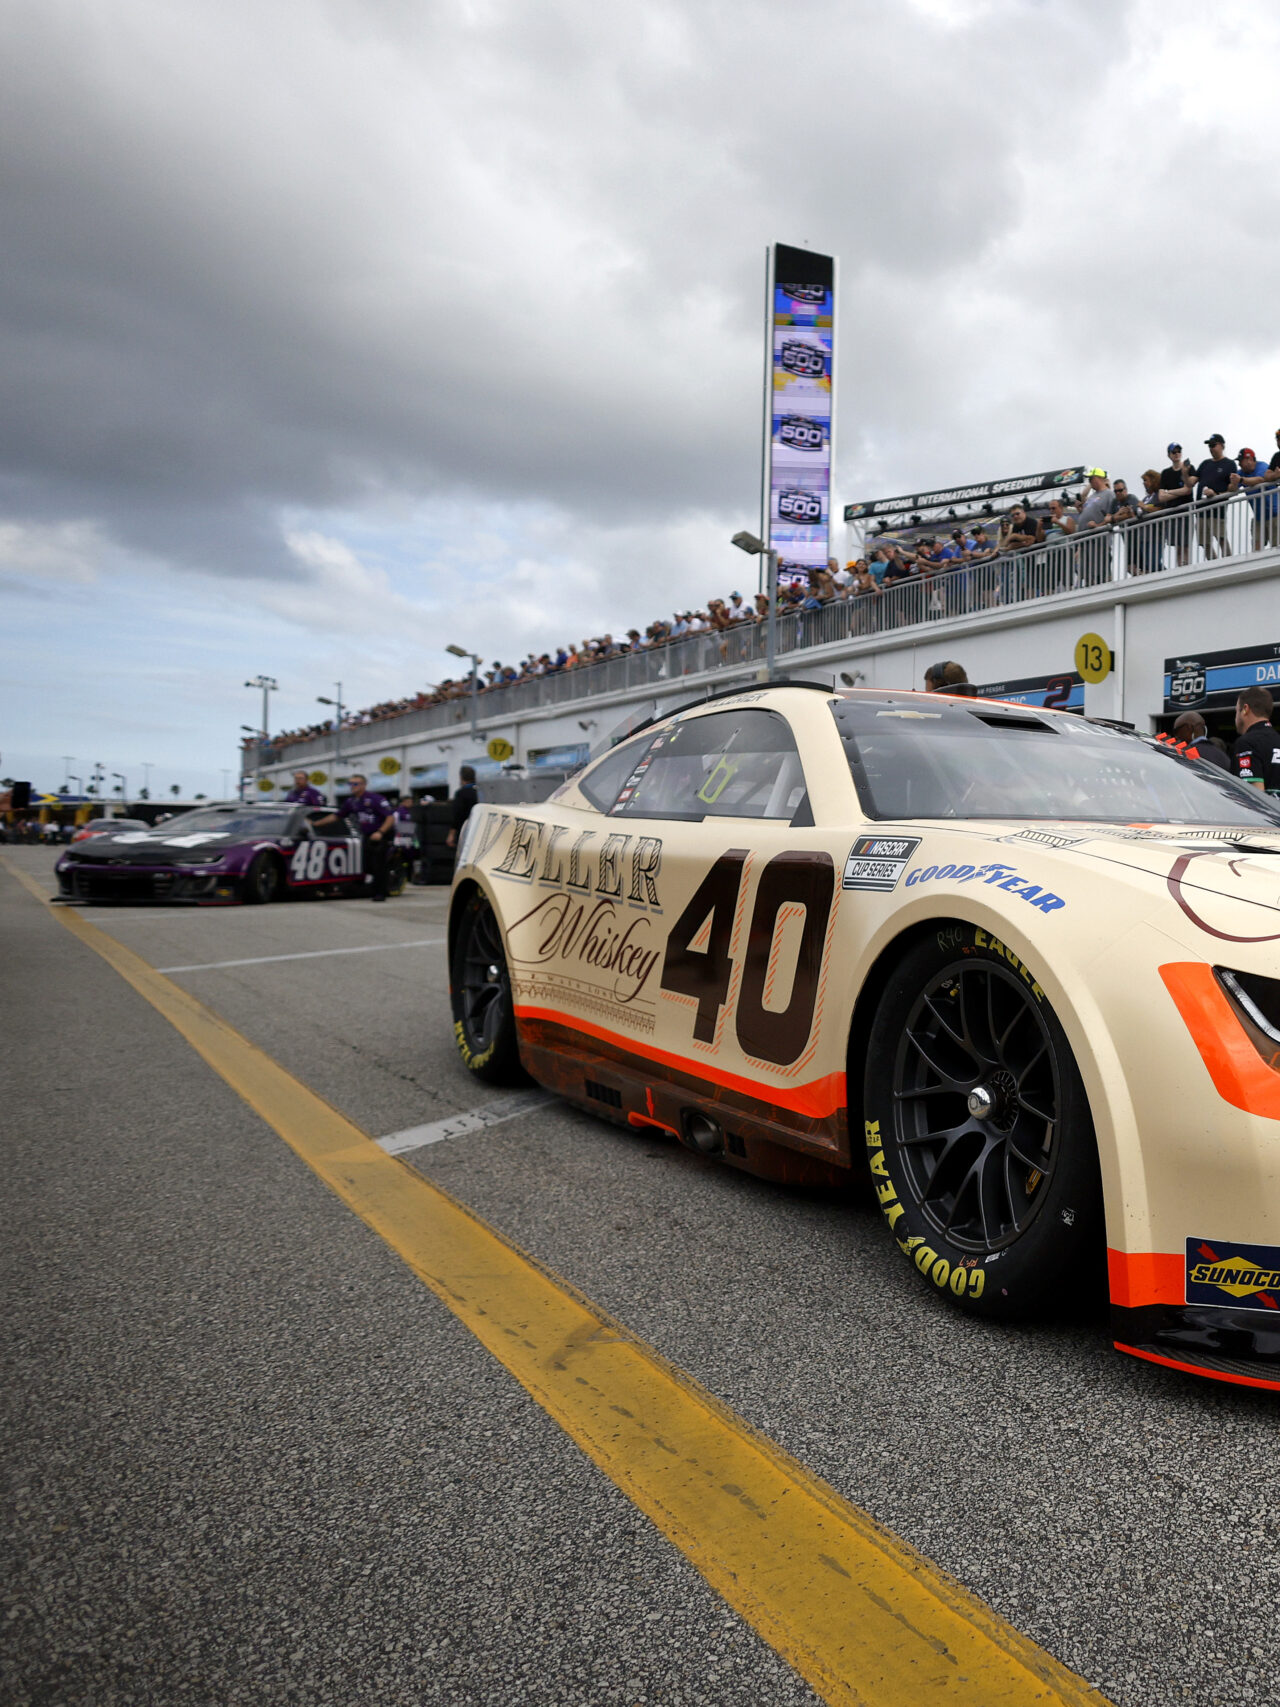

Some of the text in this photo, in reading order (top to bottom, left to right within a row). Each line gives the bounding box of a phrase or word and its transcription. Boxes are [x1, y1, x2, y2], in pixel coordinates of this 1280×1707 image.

[782, 350, 824, 371] 500
[781, 425, 822, 443] 500
[779, 497, 820, 516] 500
[873, 476, 1045, 512] DAYTONA INTERNATIONAL SPEEDWAY
[1081, 643, 1103, 672] 13
[1043, 676, 1074, 711] 2
[1171, 676, 1205, 696] 500
[290, 837, 364, 881] 48 all
[869, 840, 909, 856] NASCAR
[852, 861, 897, 878] CUP SERIES
[905, 863, 1066, 914] GOODYEAR
[506, 893, 661, 1002] Whiskey
[660, 849, 837, 1067] 40
[974, 927, 1045, 1003] EAGLE
[864, 1119, 986, 1299] GOODYEAR
